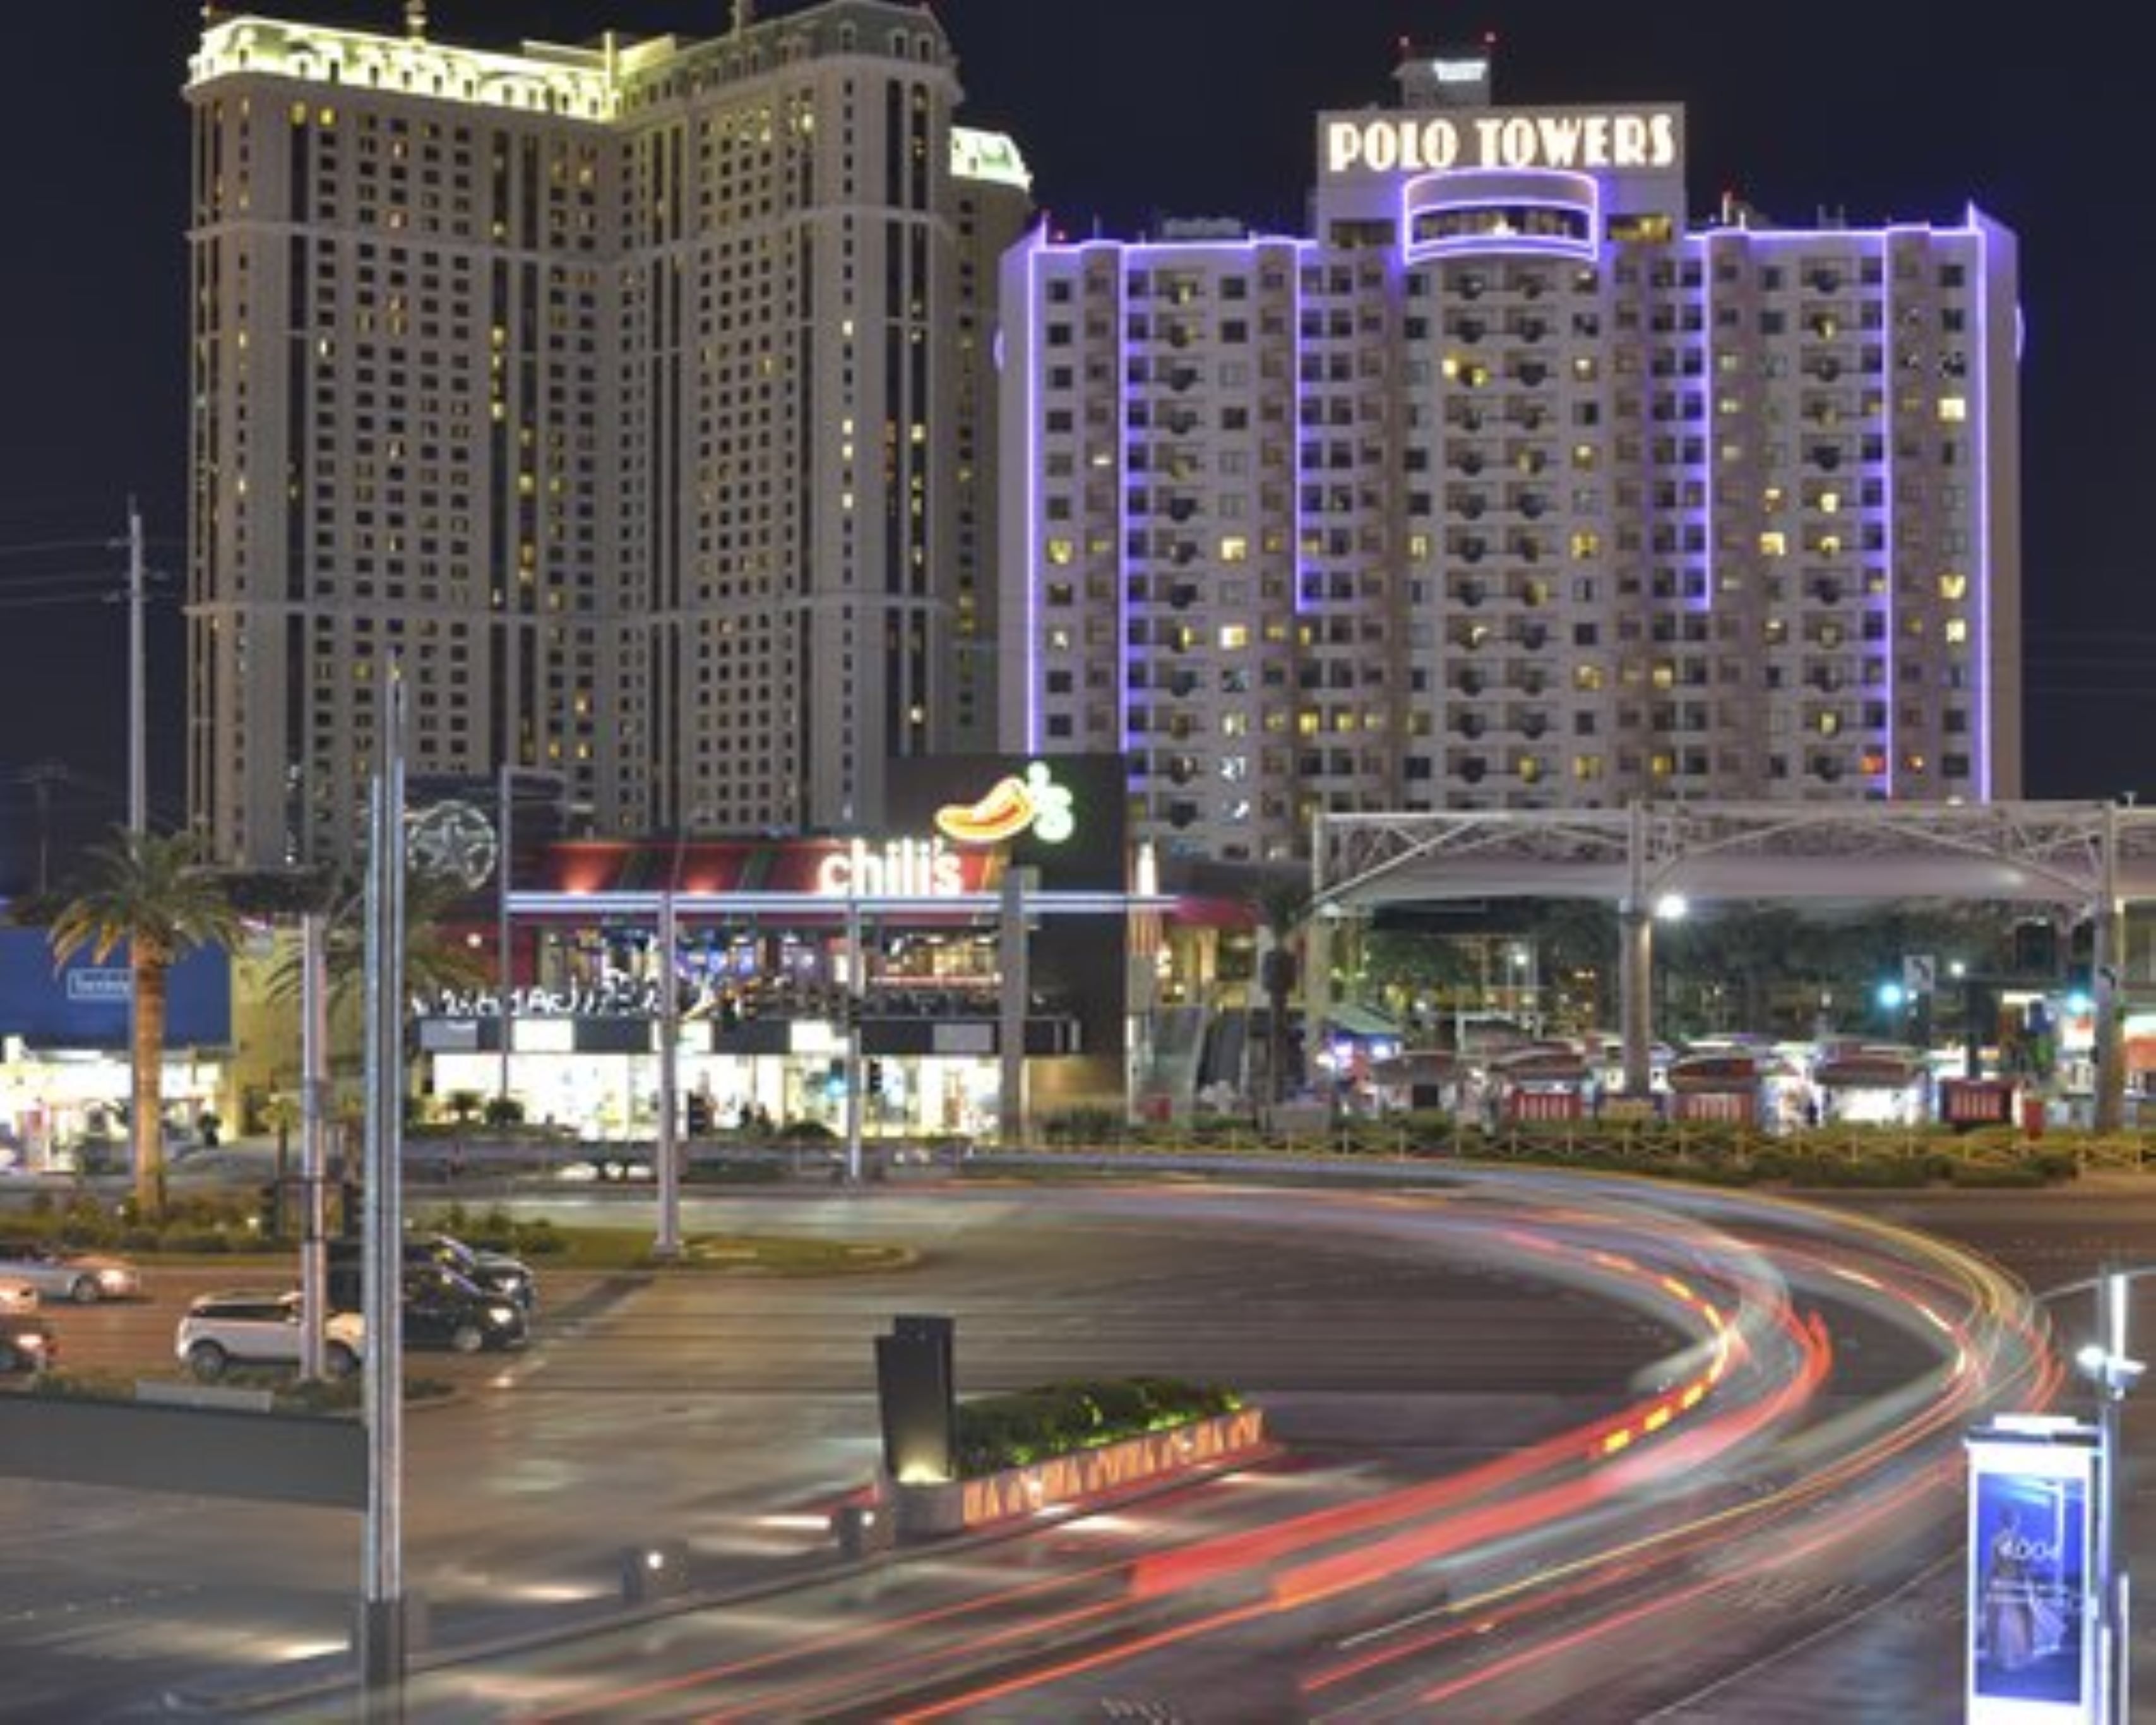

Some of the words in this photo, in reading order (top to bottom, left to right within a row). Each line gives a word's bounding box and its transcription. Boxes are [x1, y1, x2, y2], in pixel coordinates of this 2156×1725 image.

[1329, 120, 1458, 172] POLO
[1475, 114, 1674, 169] TOWERS
[818, 835, 963, 897] chili's
